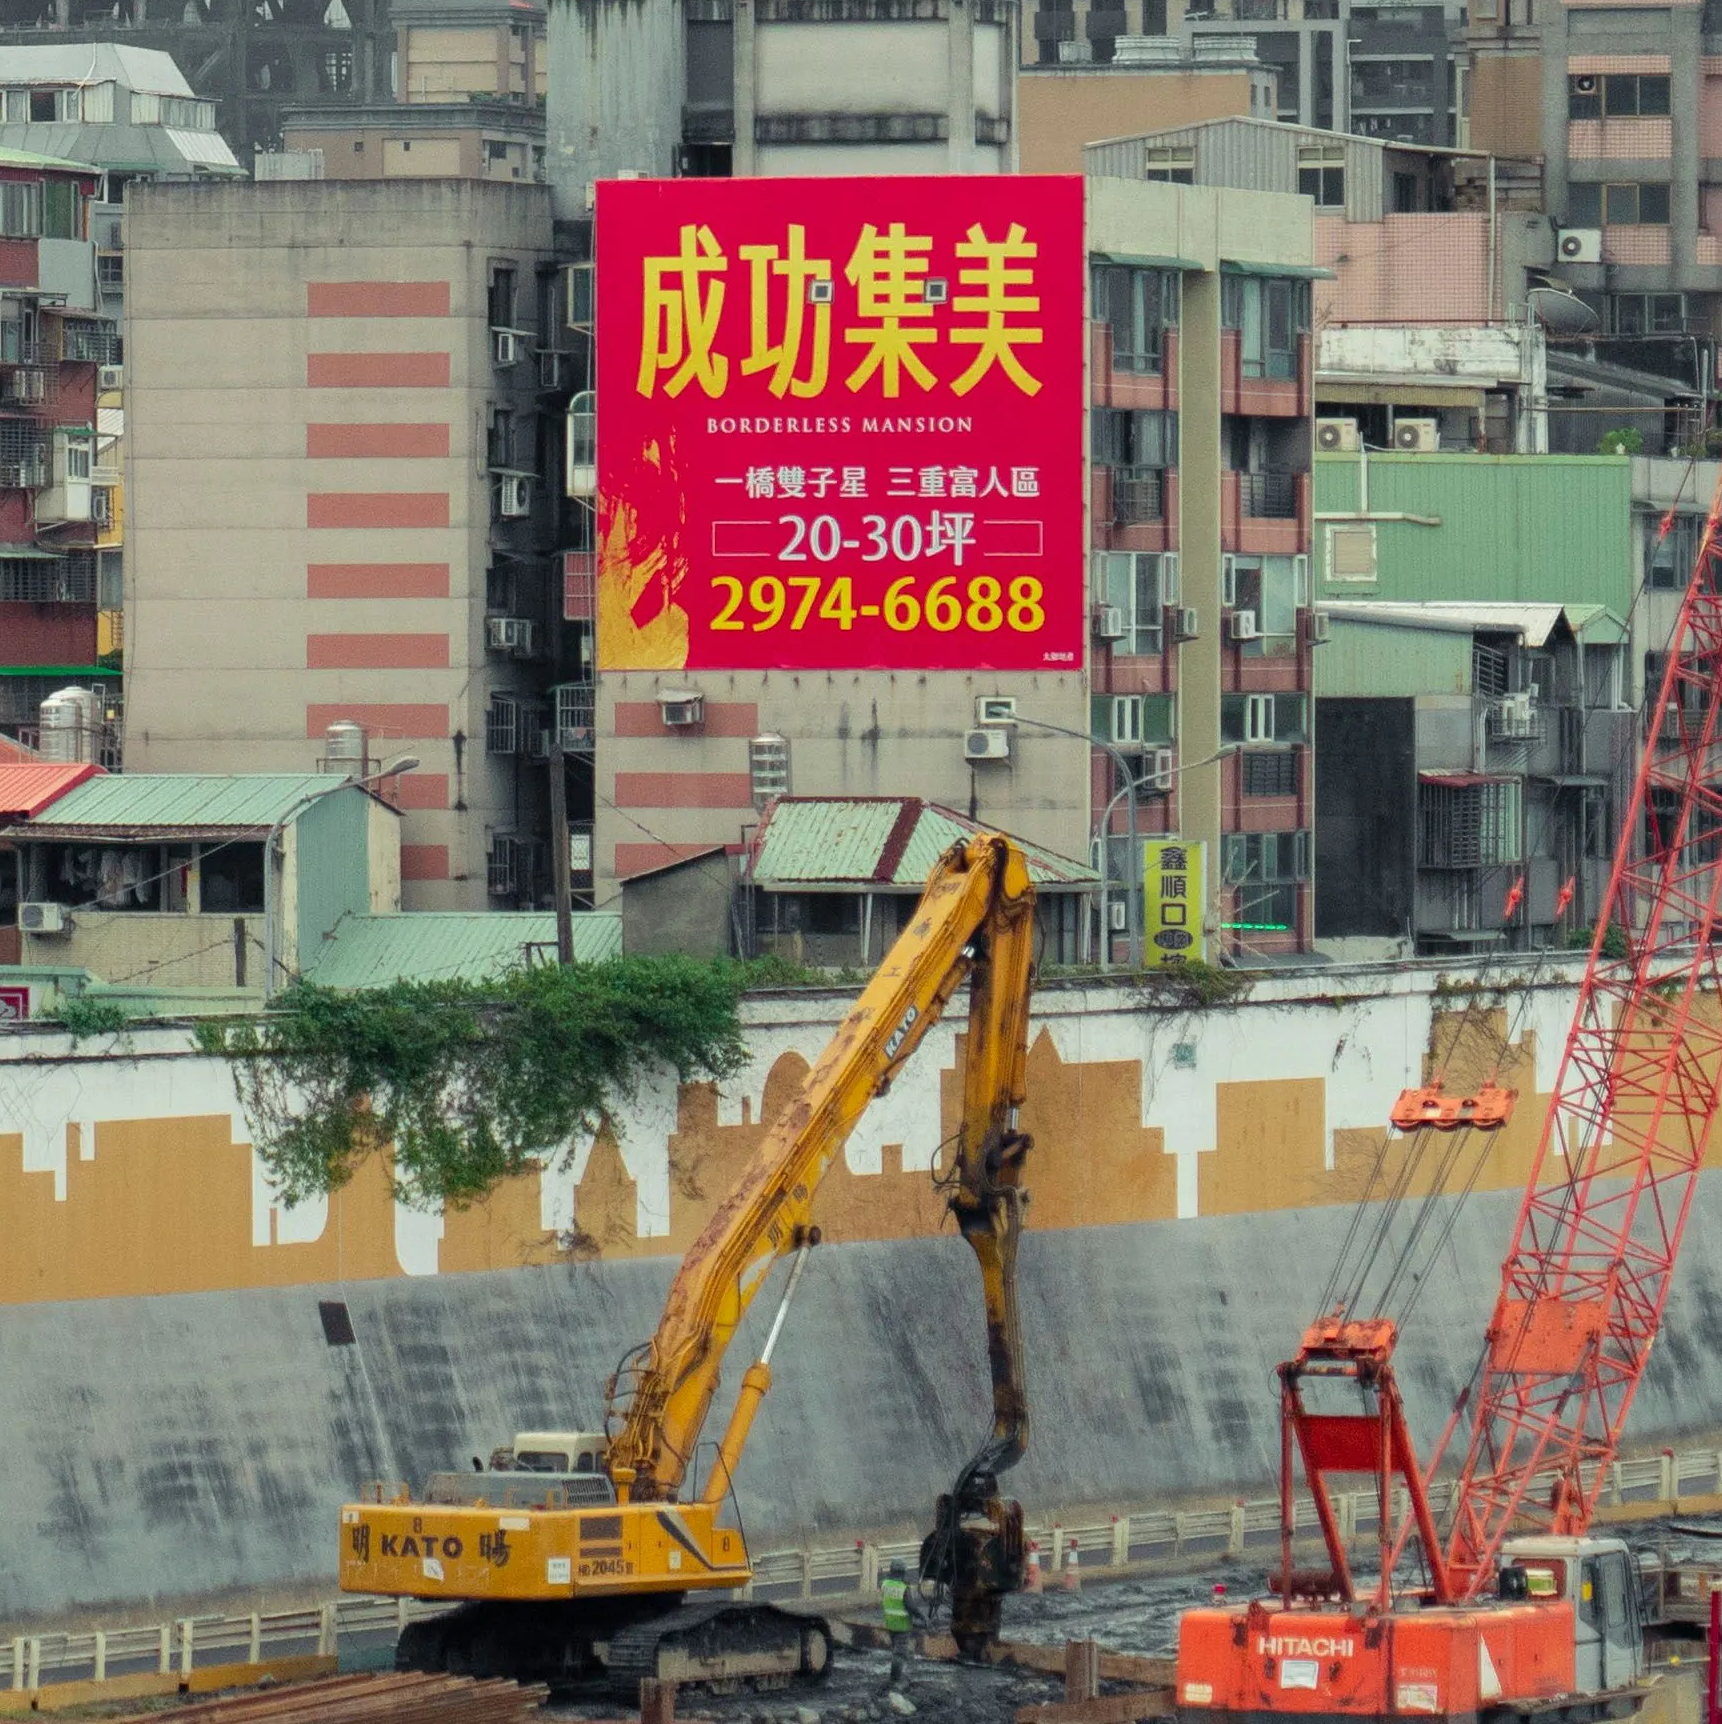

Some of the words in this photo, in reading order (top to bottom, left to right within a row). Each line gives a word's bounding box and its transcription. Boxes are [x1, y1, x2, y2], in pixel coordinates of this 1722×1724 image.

[636, 222, 1044, 399] 成功集美
[706, 416, 852, 435] BORDERLESS
[862, 416, 974, 434] MANSION
[714, 466, 869, 500] 一橋雙子星
[886, 466, 1041, 499] 三重富人區
[778, 510, 977, 567] 20-30坪
[709, 575, 1046, 634] 2974-6688
[885, 1006, 917, 1058] KATO
[352, 1524, 371, 1564] 明
[381, 1534, 464, 1559] KATO
[592, 1559, 625, 1576] 2045
[1258, 1636, 1355, 1658] HITACHI
